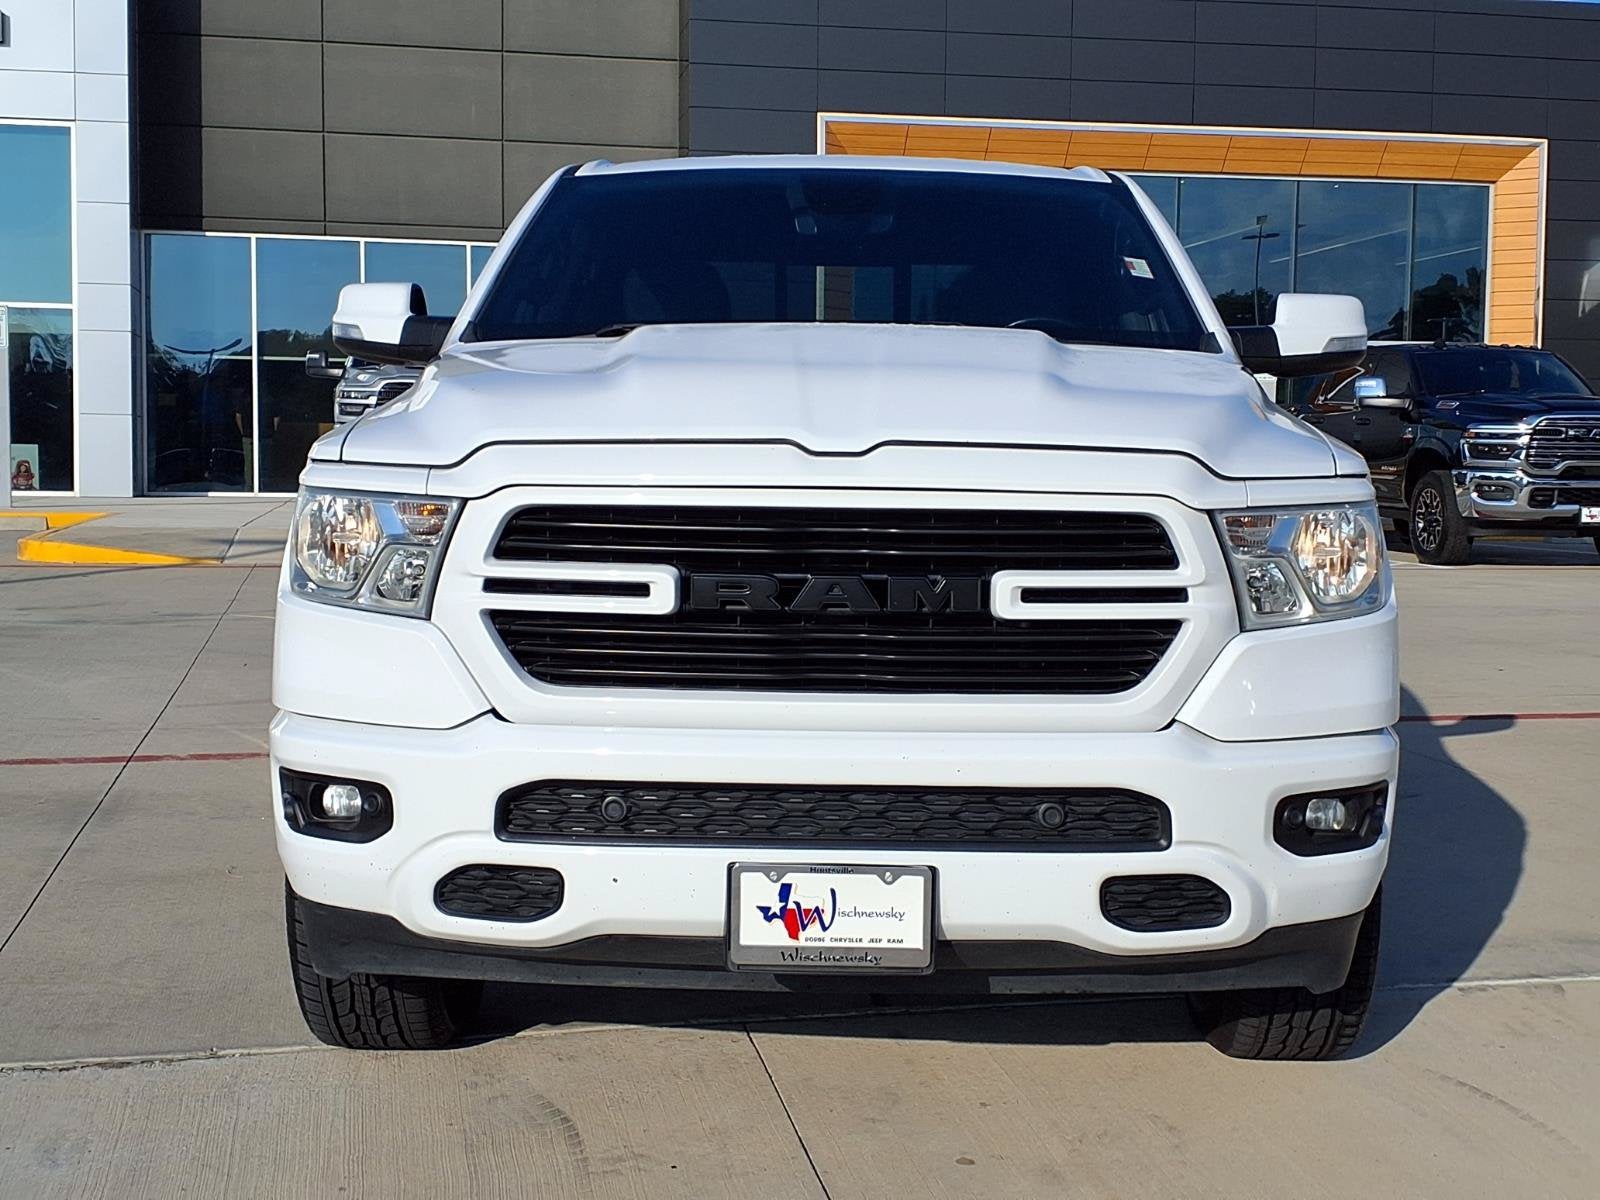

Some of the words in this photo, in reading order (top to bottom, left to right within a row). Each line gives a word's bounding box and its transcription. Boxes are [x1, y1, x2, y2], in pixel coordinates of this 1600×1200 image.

[690, 573, 982, 613] RAM
[793, 887, 906, 933] Wischnewsky
[829, 936, 864, 944] CHRYSLER
[781, 947, 883, 966] Wischnewsky
